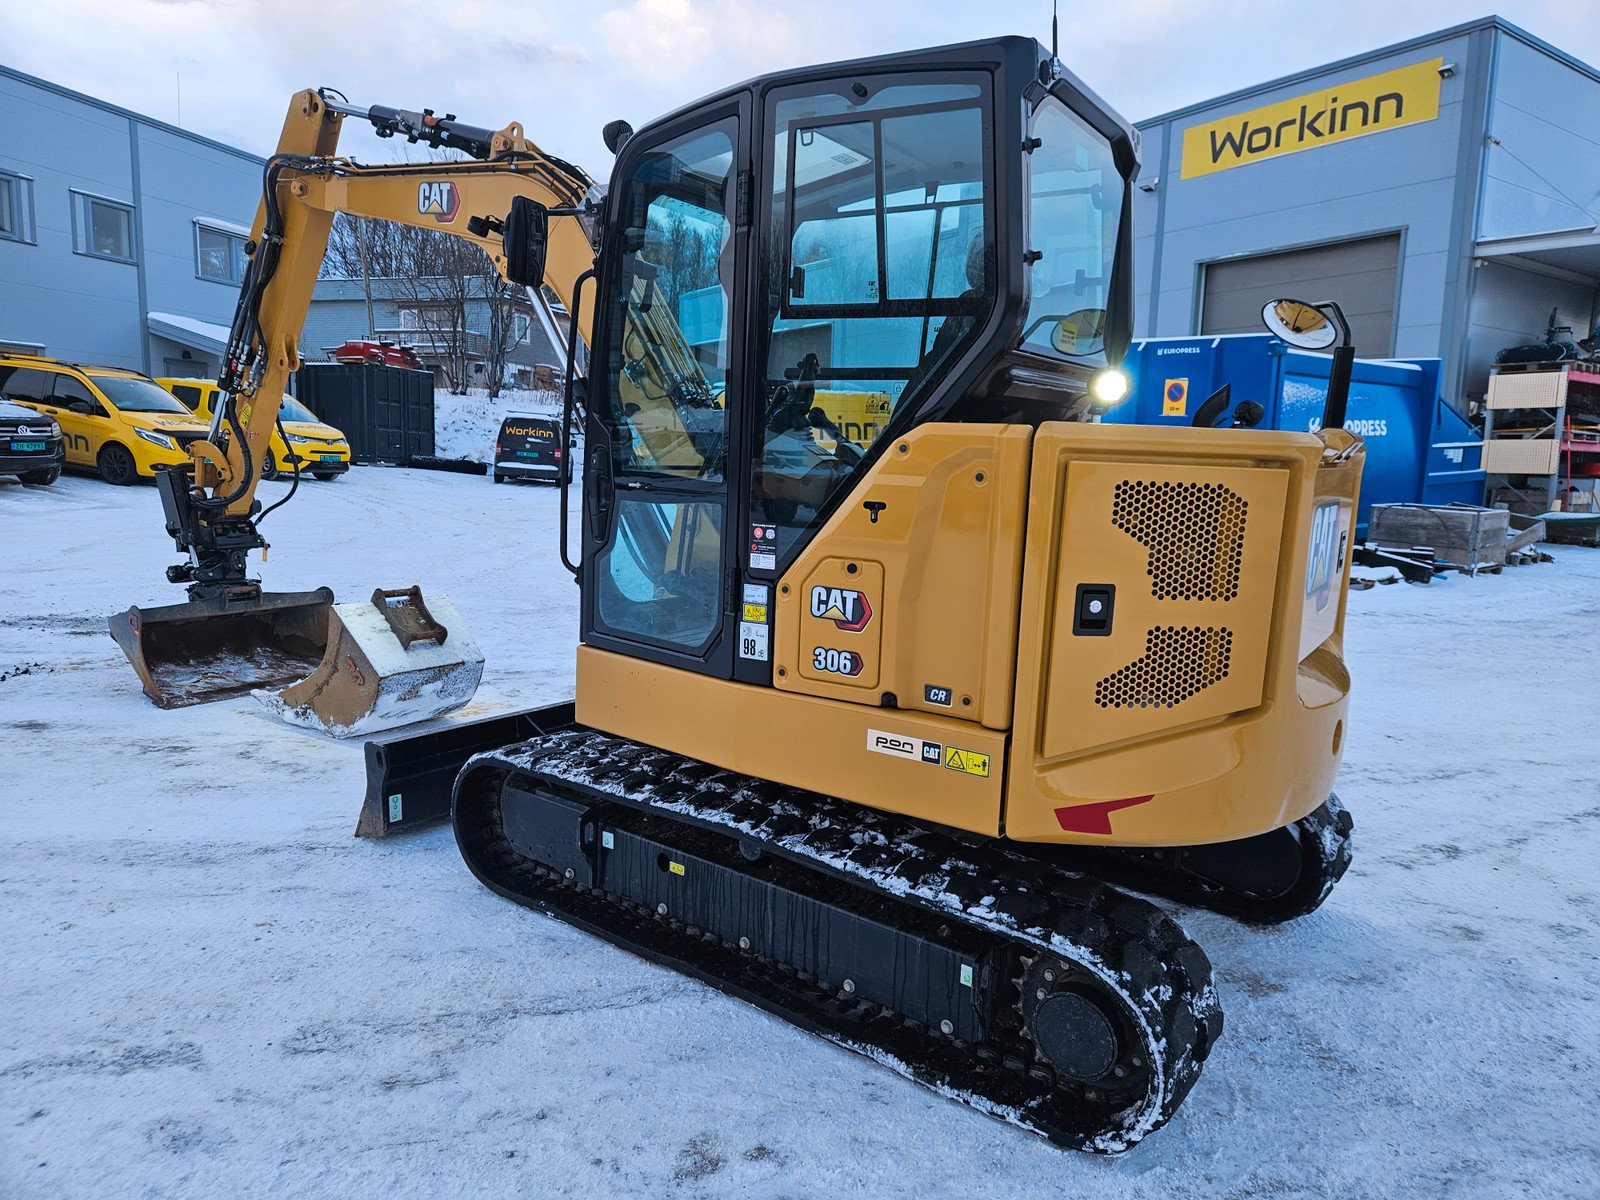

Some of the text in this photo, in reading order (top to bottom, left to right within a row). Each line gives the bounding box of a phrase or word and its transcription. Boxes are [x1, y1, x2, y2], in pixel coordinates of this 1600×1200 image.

[1210, 92, 1404, 164] Workinn
[419, 182, 451, 213] CAT
[1164, 347, 1201, 355] EUROPRESS
[505, 426, 554, 438] Workinn
[1343, 419, 1387, 436] OPRESS
[1307, 504, 1339, 594] CAT
[811, 585, 858, 622] CAT
[743, 638, 756, 656] 98
[814, 647, 852, 674] 306
[929, 689, 947, 702] CR
[923, 746, 940, 760] CAT
